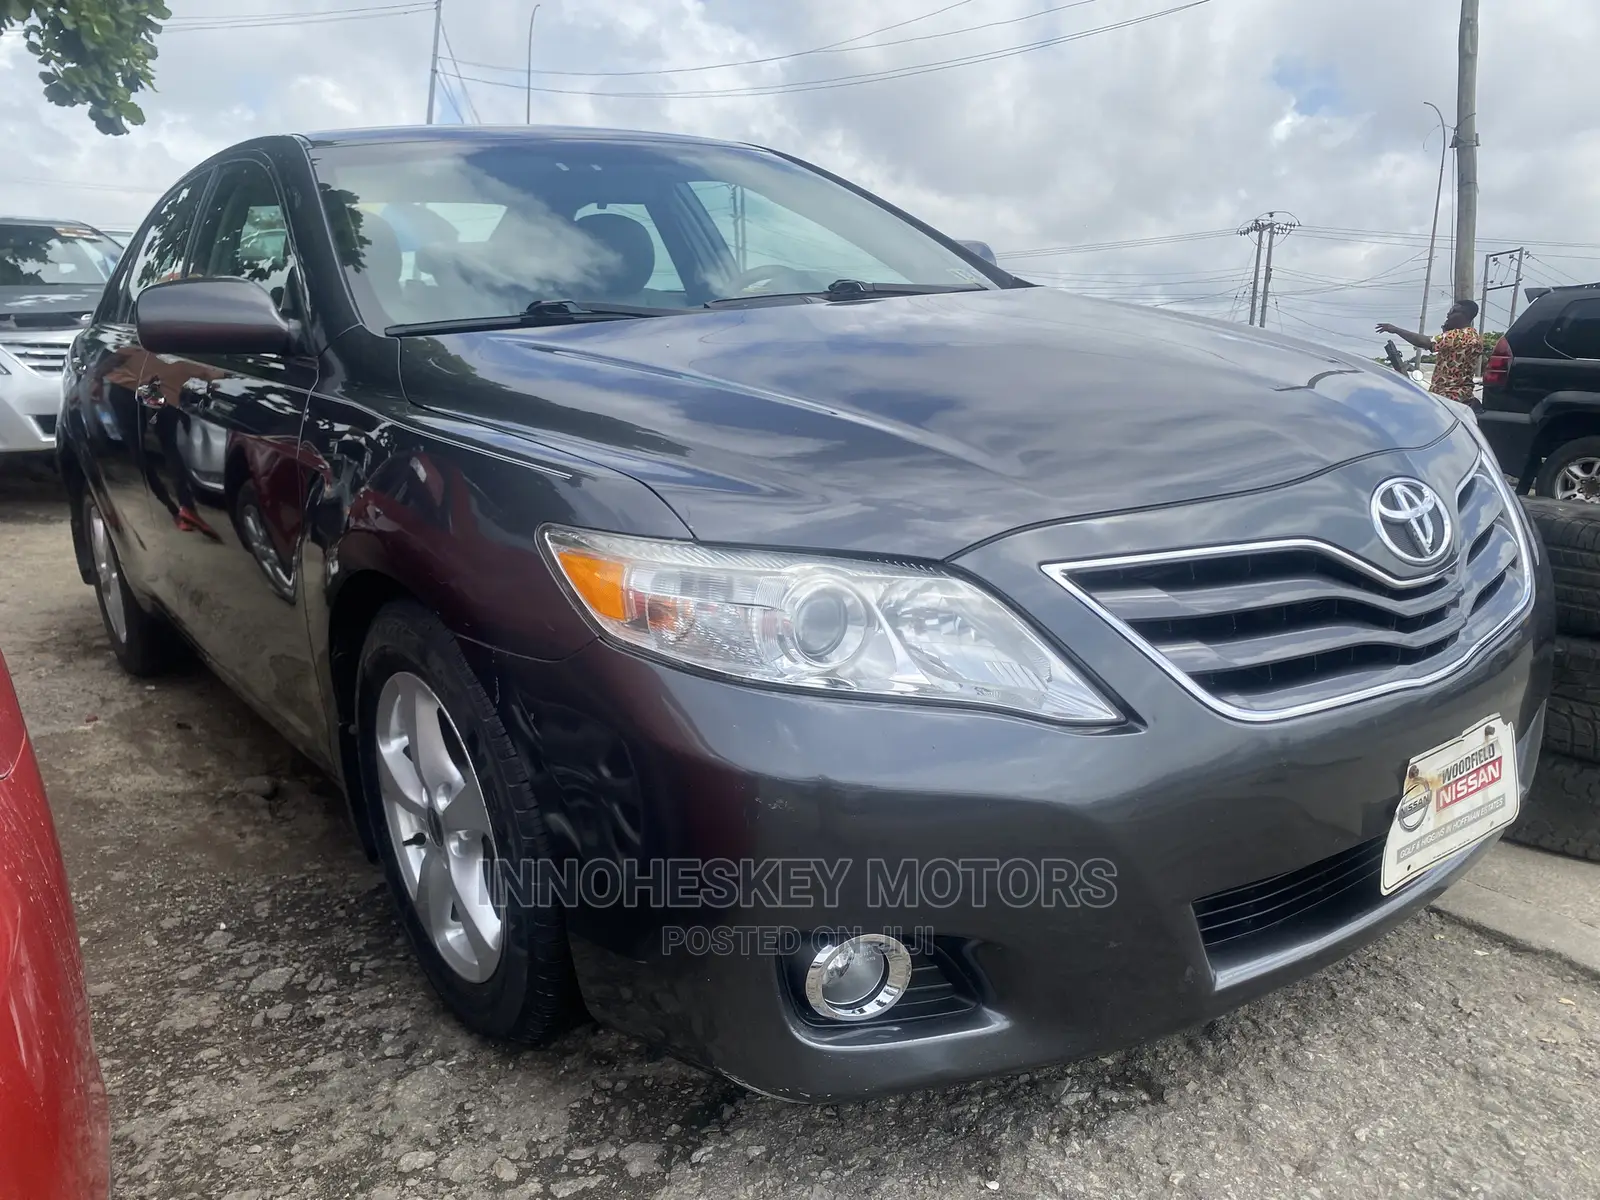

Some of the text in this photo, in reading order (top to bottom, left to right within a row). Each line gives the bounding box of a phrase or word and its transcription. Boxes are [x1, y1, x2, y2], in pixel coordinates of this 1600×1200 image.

[1442, 743, 1496, 784] WOODFIELD
[1439, 762, 1500, 807] NISSAN
[1400, 793, 1429, 816] NISSAN
[1400, 844, 1416, 859] GOLF
